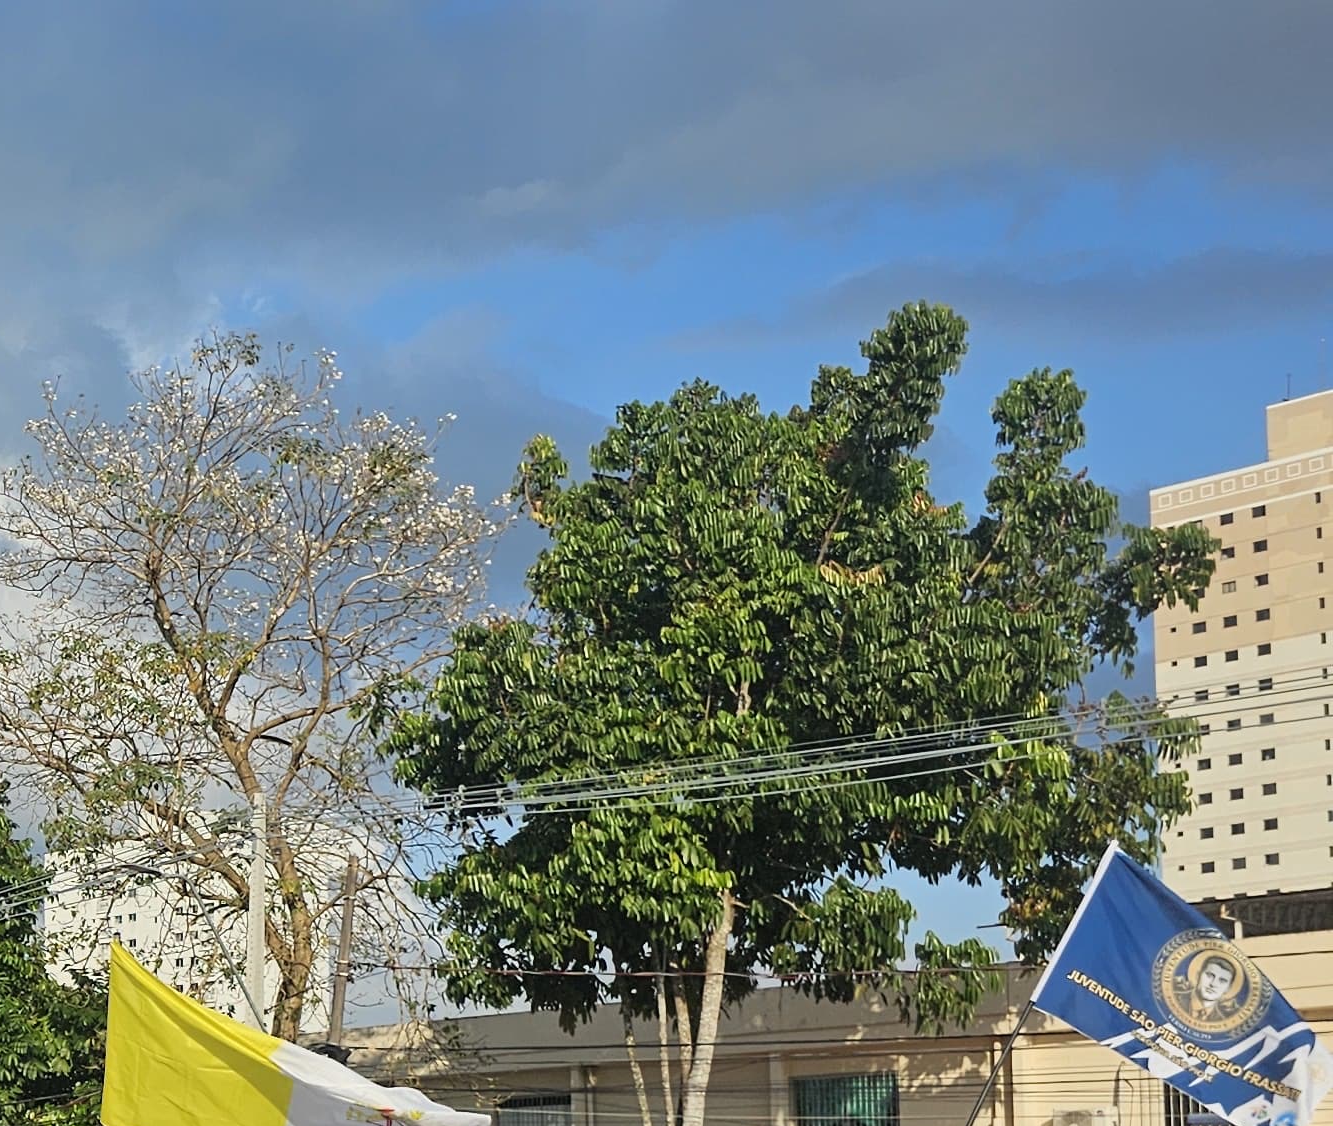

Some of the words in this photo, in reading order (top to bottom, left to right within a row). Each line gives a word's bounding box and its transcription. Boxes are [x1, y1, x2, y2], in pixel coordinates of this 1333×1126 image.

[1066, 969, 1131, 1015] JUVENTUDE
[1129, 1011, 1156, 1032] SÃO
[1155, 1025, 1184, 1049] PIER
[1181, 1044, 1244, 1077] GIORGIO
